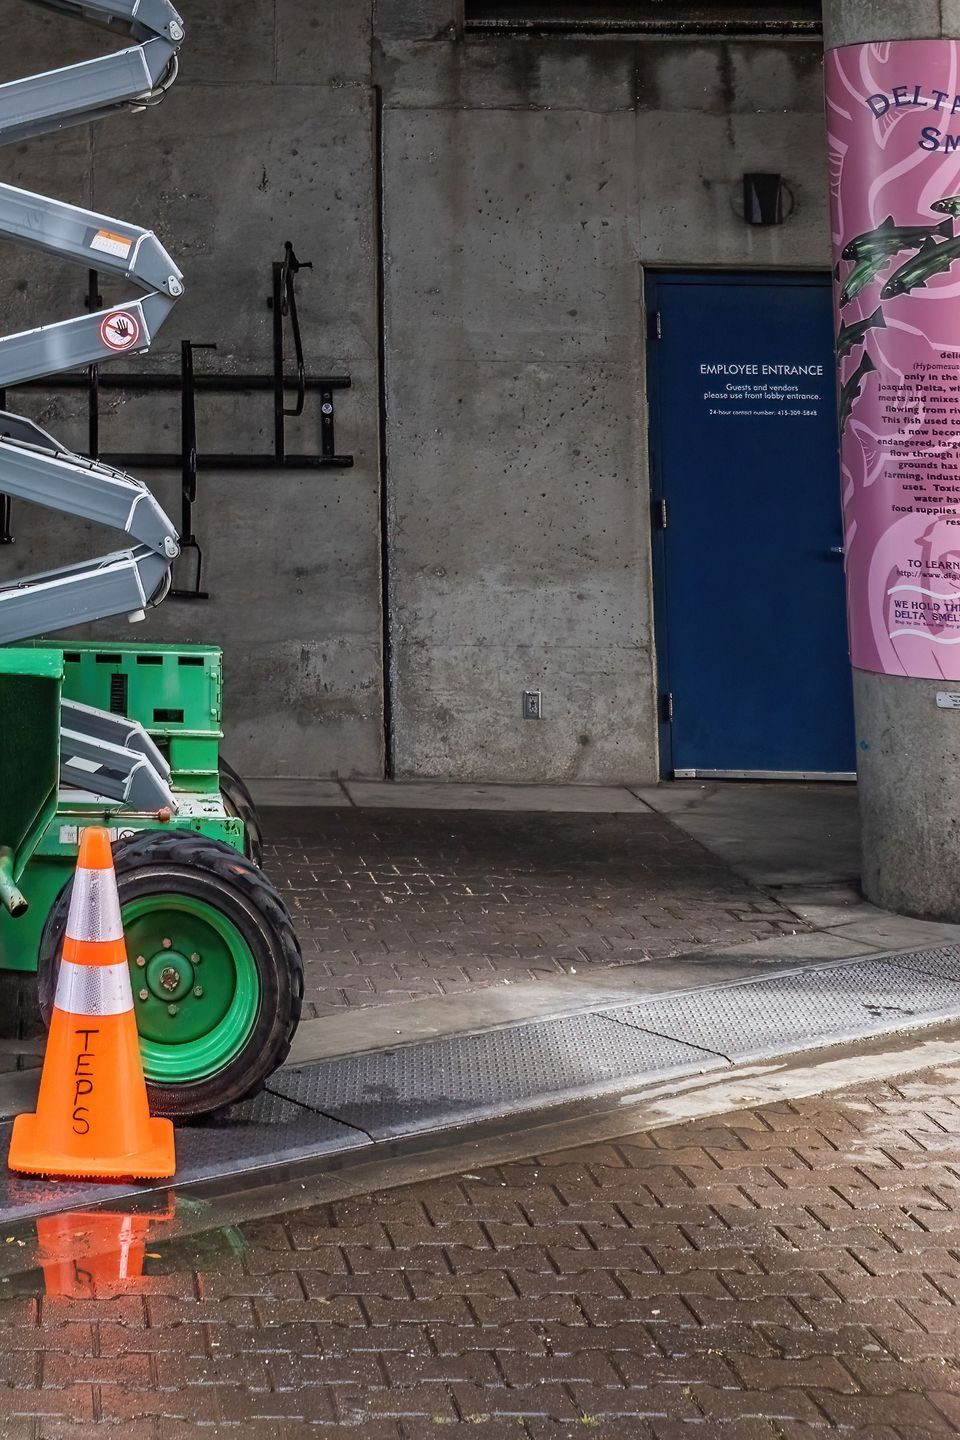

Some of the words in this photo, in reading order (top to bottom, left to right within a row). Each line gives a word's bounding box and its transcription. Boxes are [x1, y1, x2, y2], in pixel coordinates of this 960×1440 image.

[700, 364, 758, 375] EMPLOYEE
[762, 365, 823, 376] ENTRANCE
[768, 384, 798, 392] vendors
[878, 384, 912, 392] Joaquin
[704, 392, 728, 400] please
[764, 392, 784, 400] lobby
[885, 406, 919, 415] flowing
[904, 416, 921, 424] fish
[878, 439, 935, 447] endangered,
[913, 451, 953, 460] through
[884, 471, 923, 481] farming,
[916, 506, 956, 515] supplies
[907, 559, 922, 568] TO
[926, 560, 960, 570] LEARN
[894, 600, 909, 608] WE
[912, 602, 940, 611] HOLD
[944, 603, 960, 612] TH
[895, 610, 926, 620] DELTA
[932, 614, 960, 622] SMEL
[72, 1029, 100, 1135] TEPS
